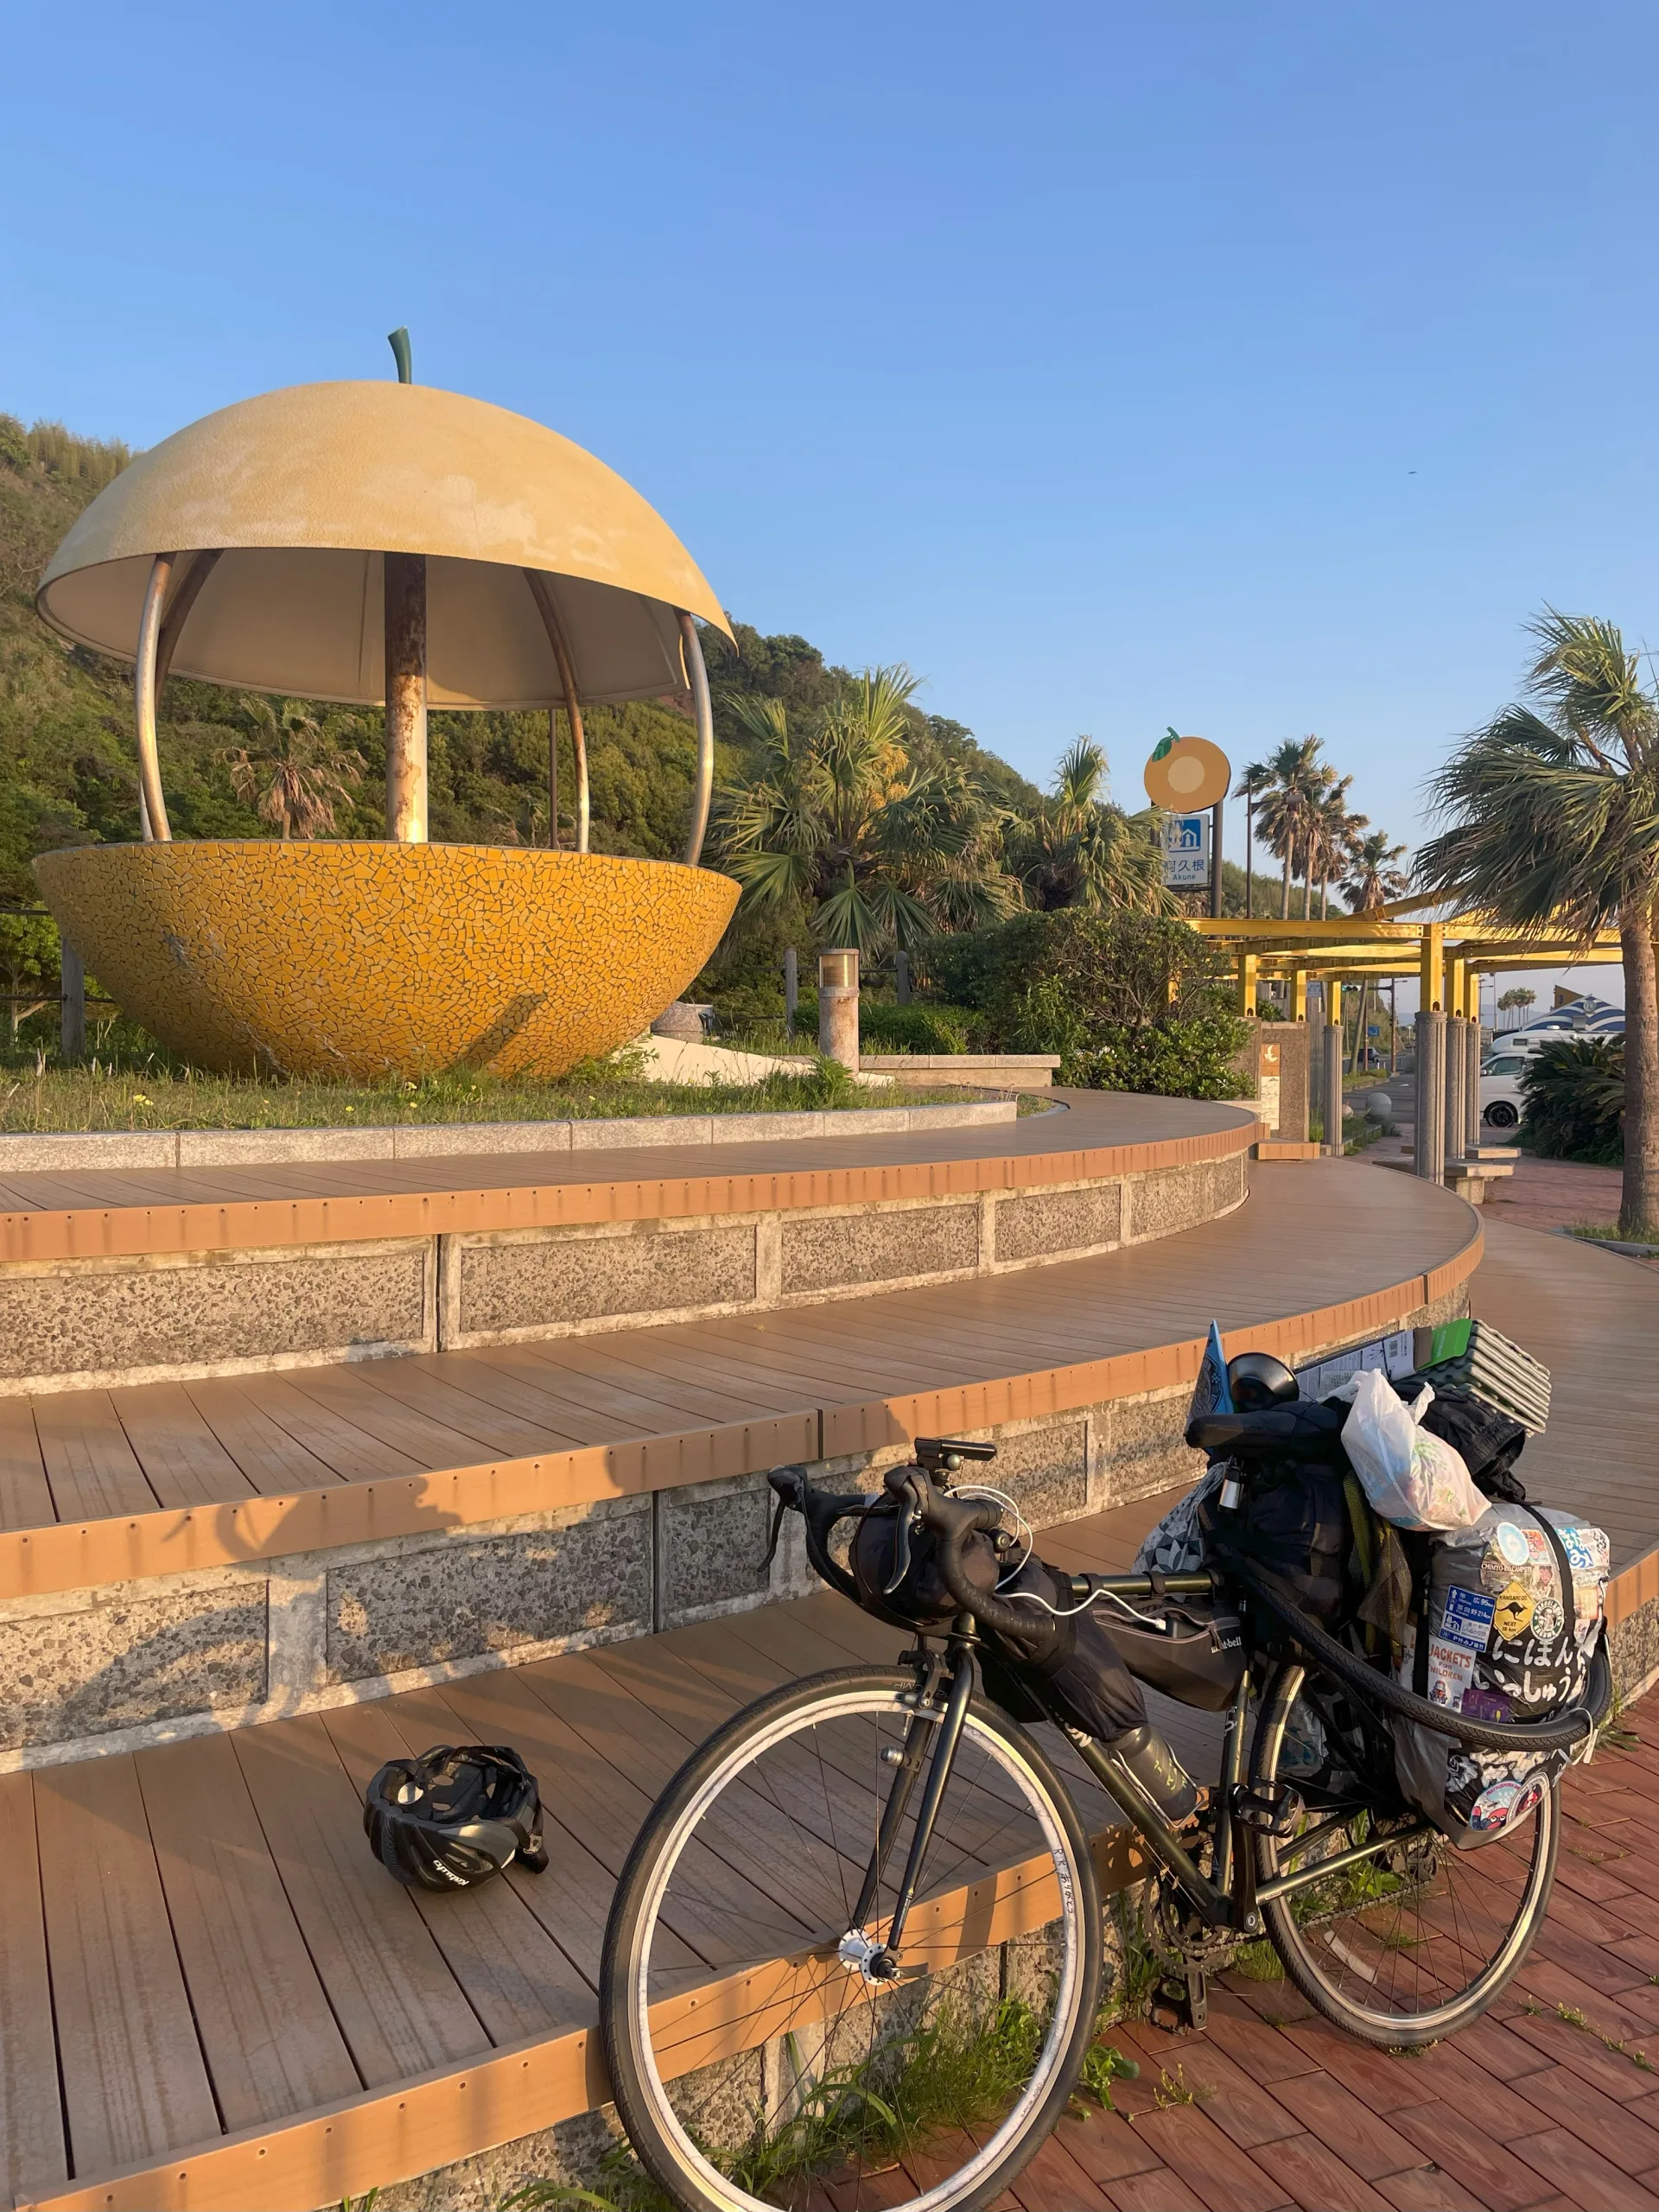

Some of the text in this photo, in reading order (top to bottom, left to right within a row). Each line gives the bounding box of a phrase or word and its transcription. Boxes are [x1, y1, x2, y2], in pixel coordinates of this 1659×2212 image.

[1163, 859, 1205, 872] 阿久根
[1428, 1643, 1472, 1668] JACKETS
[1492, 1636, 1573, 1667] にほん
[1430, 1665, 1463, 1681] HILDREN
[1438, 1661, 1452, 1670] FOR
[433, 1859, 469, 1885] Kabuto
